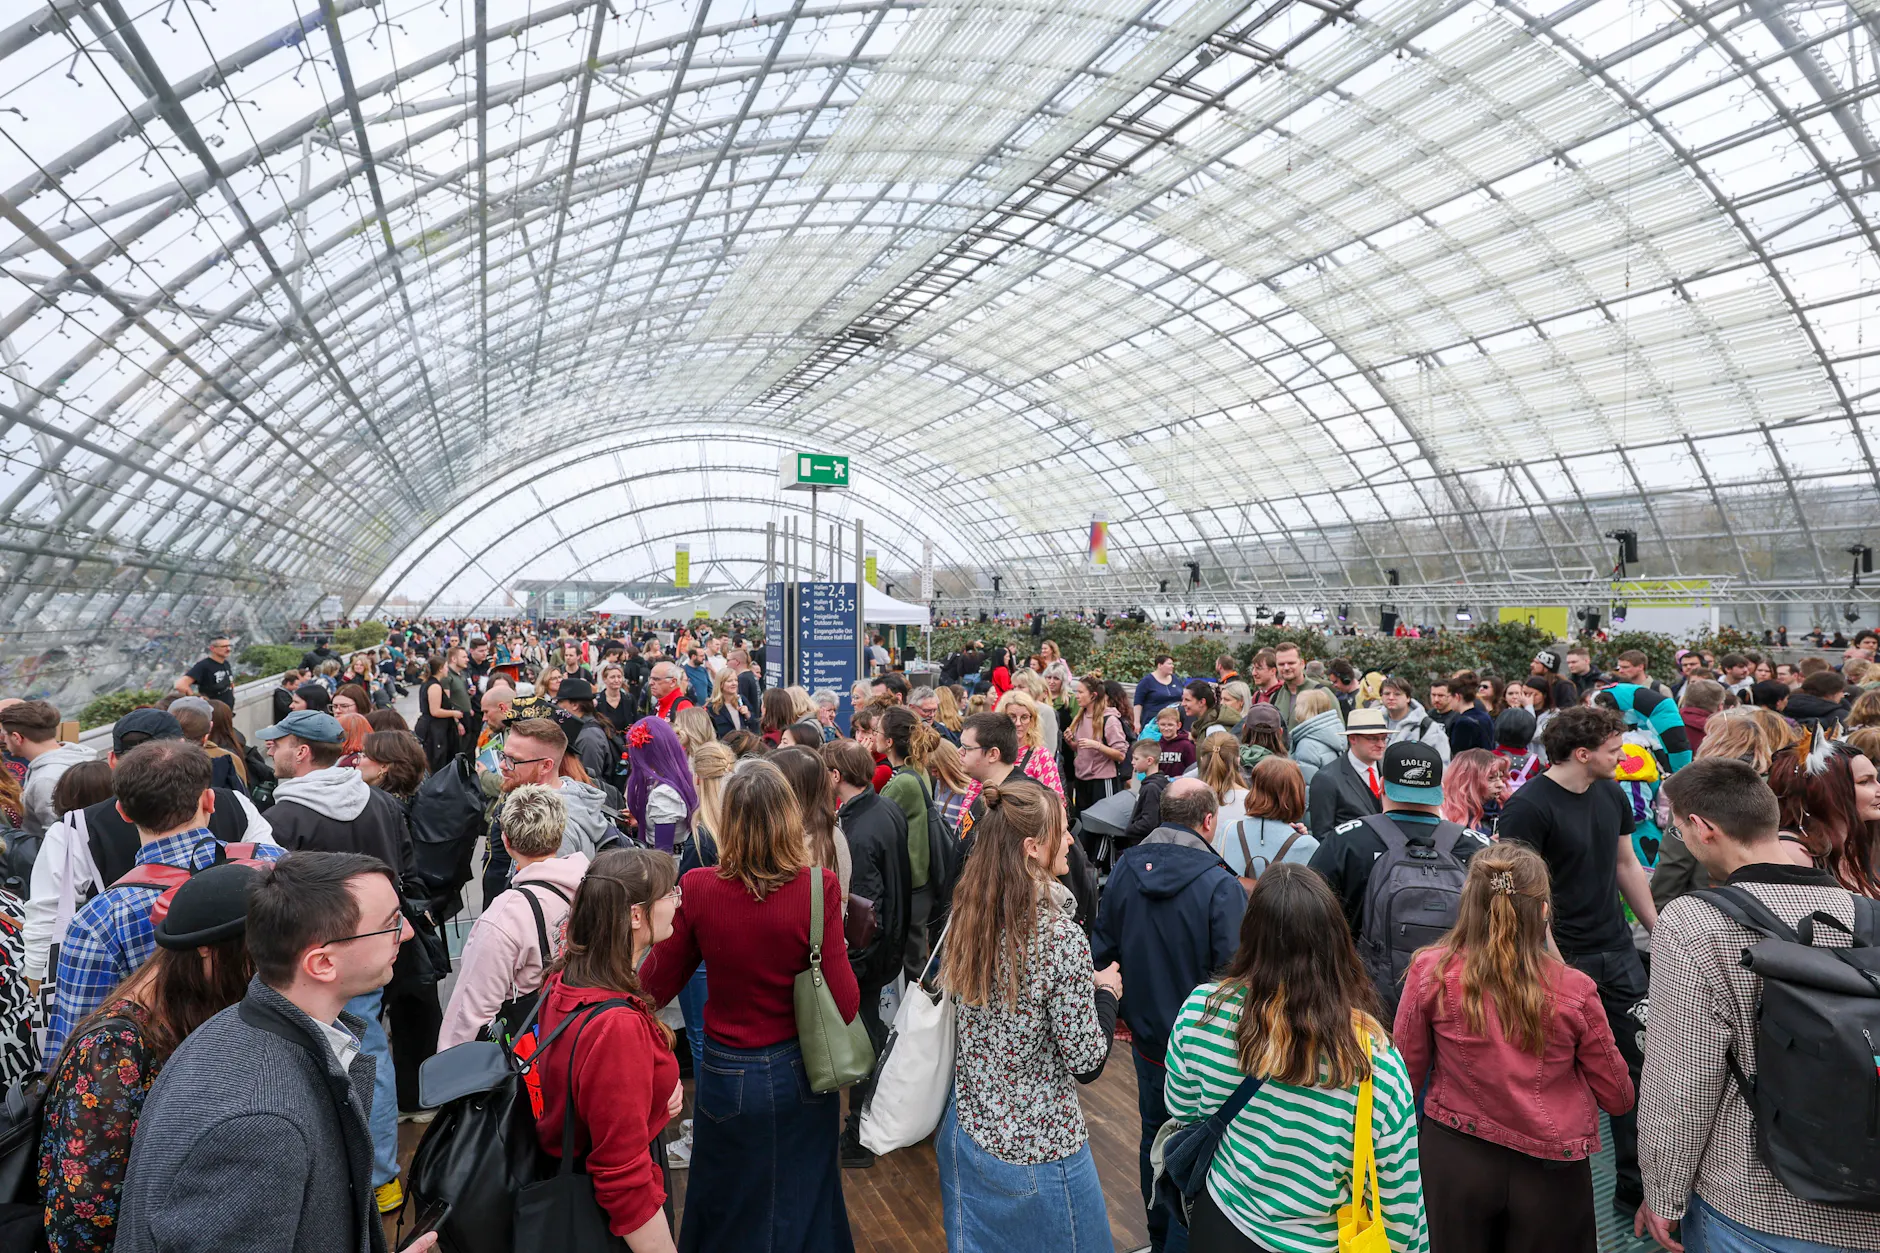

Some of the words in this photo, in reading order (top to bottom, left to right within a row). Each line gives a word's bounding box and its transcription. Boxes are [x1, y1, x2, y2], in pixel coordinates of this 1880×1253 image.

[828, 584, 846, 598] 2,4
[828, 599, 854, 613] 1,3,5
[1400, 759, 1432, 768] EAGLES
